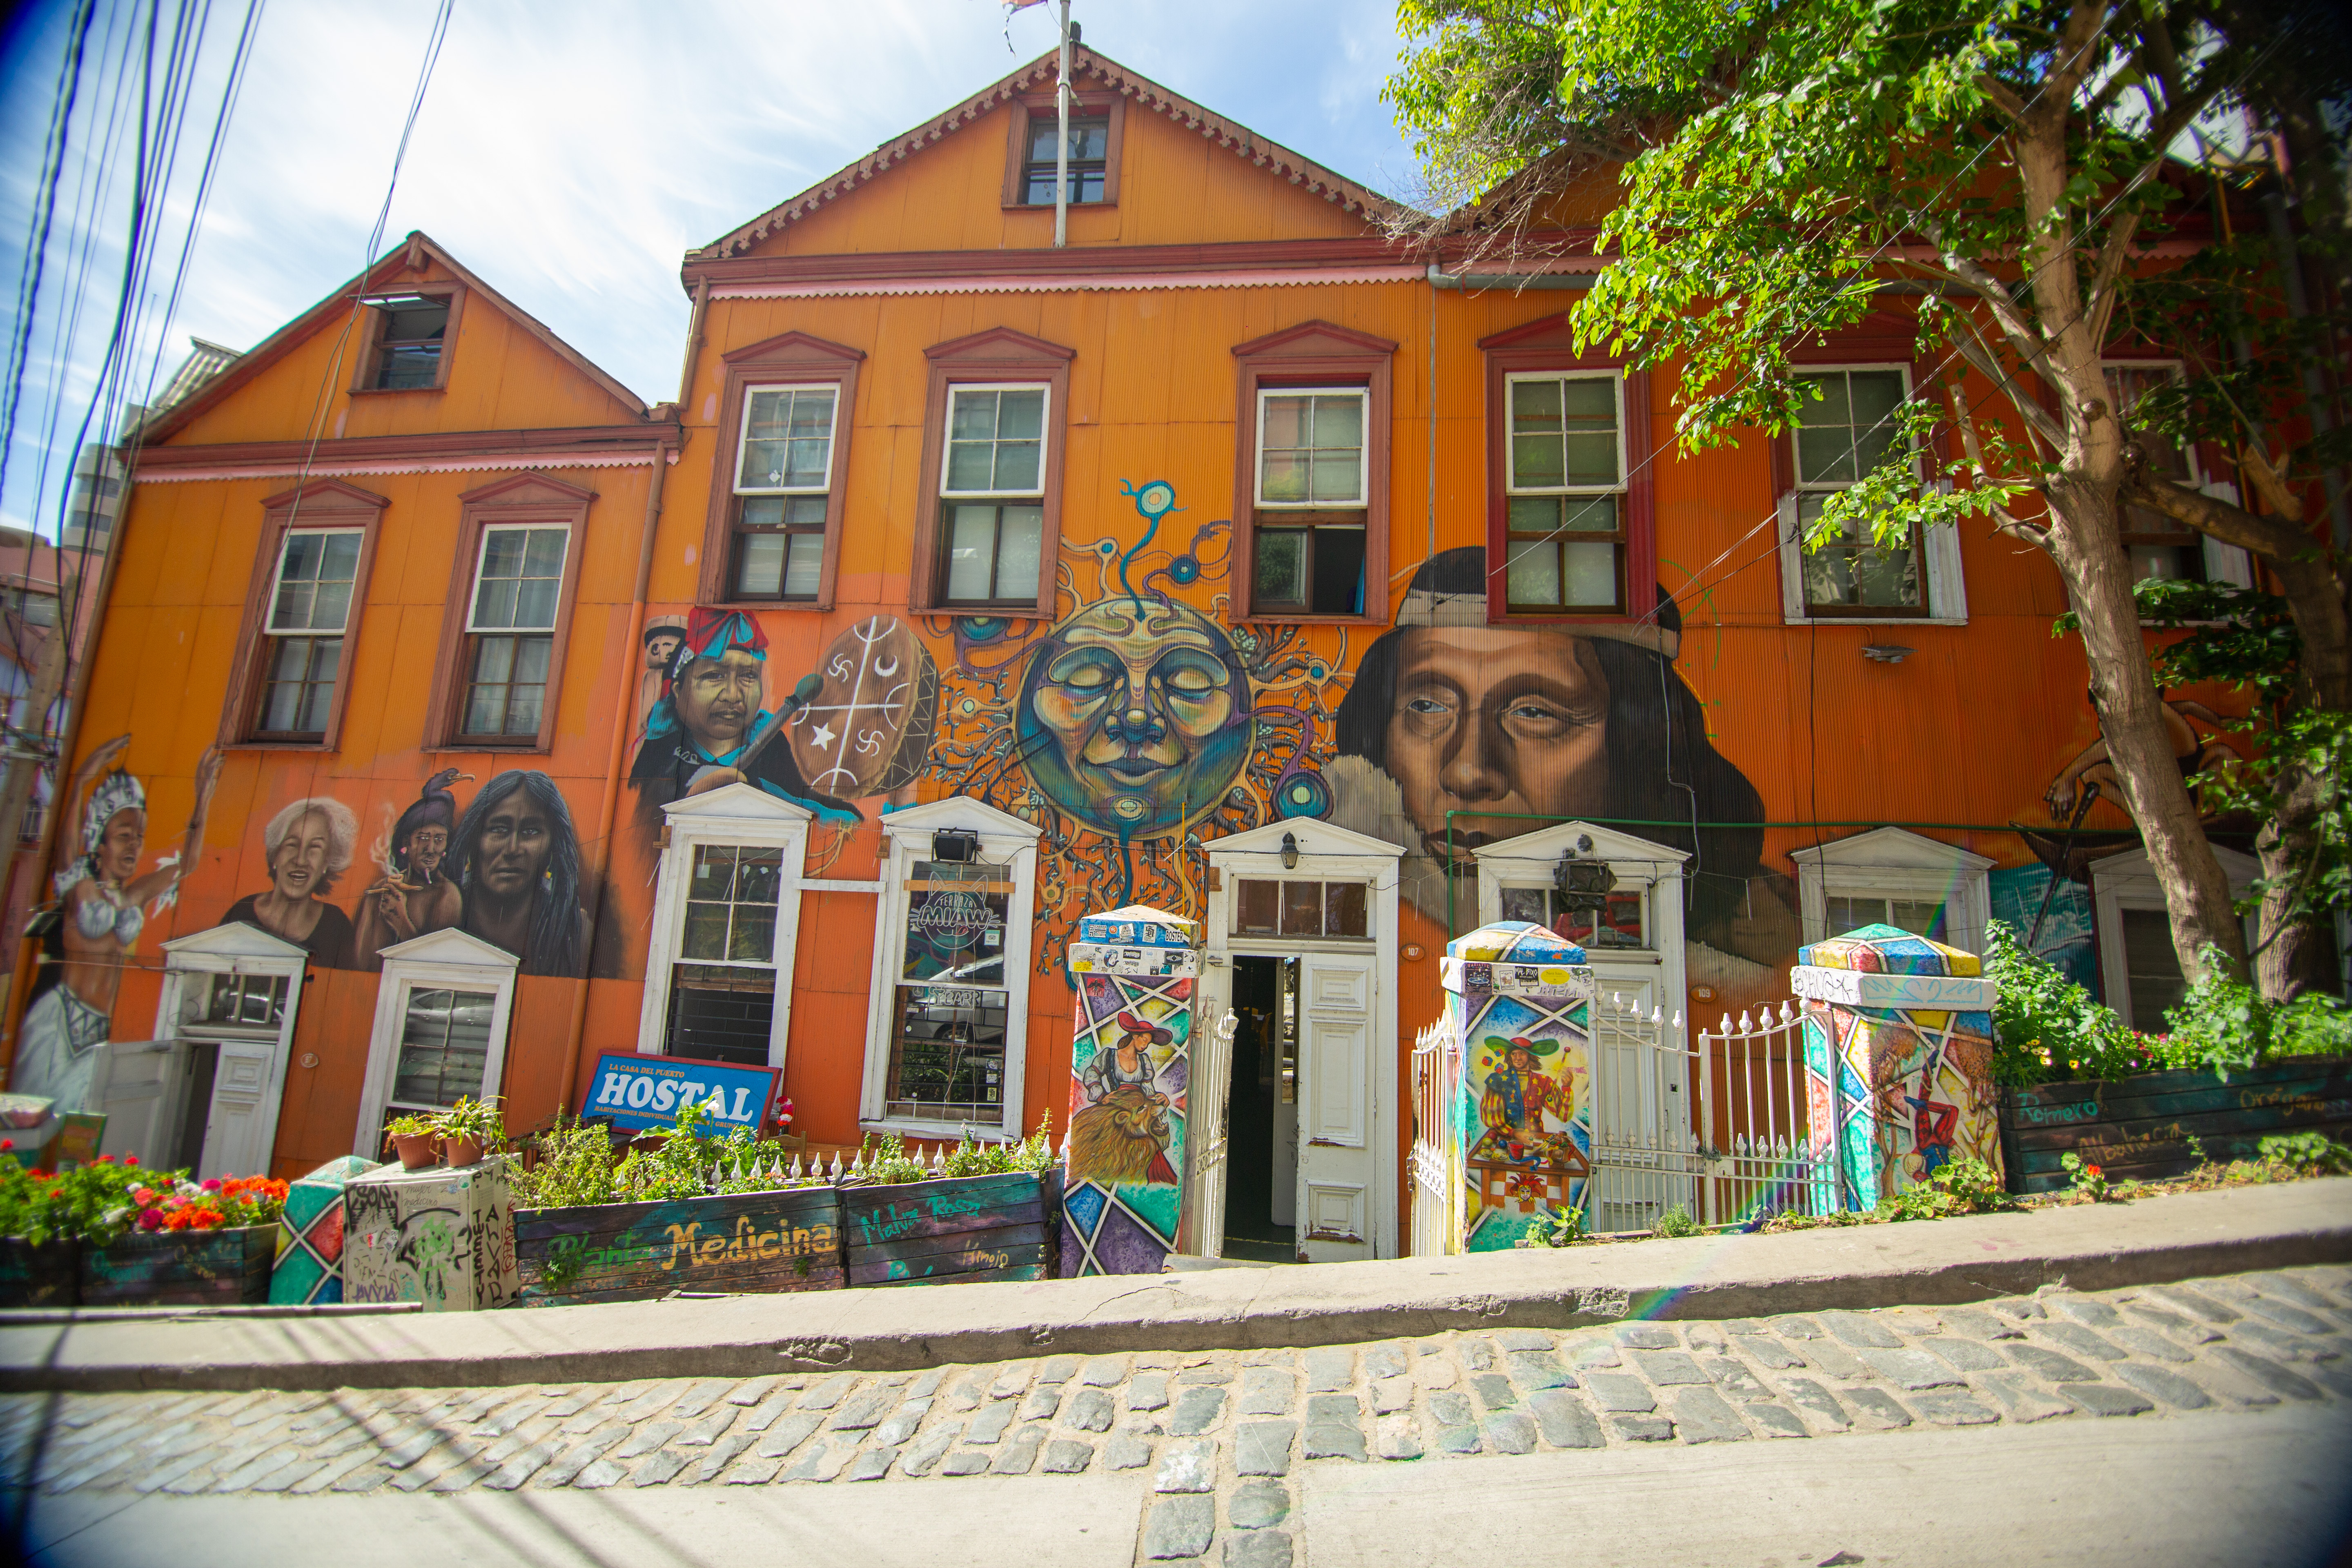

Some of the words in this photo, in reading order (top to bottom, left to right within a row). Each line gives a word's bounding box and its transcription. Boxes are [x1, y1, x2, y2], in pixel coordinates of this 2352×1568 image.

[940, 895, 973, 908] TERRAZA
[920, 906, 991, 929] MIAW
[1166, 931, 1183, 942] BOSTER
[1408, 947, 1419, 956] 107
[944, 991, 973, 1007] BAR
[1699, 989, 1710, 998] 109
[620, 1065, 639, 1073] CASA
[655, 1069, 685, 1078] PUERTO
[597, 1072, 753, 1122] HOSTAL
[594, 1106, 638, 1116] HABITACIONES
[638, 1111, 677, 1121] INDIVIDUALE
[2016, 1092, 2098, 1125] Romero
[861, 1204, 921, 1248] Malva
[926, 1196, 980, 1223] Rosa
[547, 1227, 651, 1274] Planta
[662, 1215, 837, 1270] Medicina
[962, 1240, 1009, 1268] Hinojo
